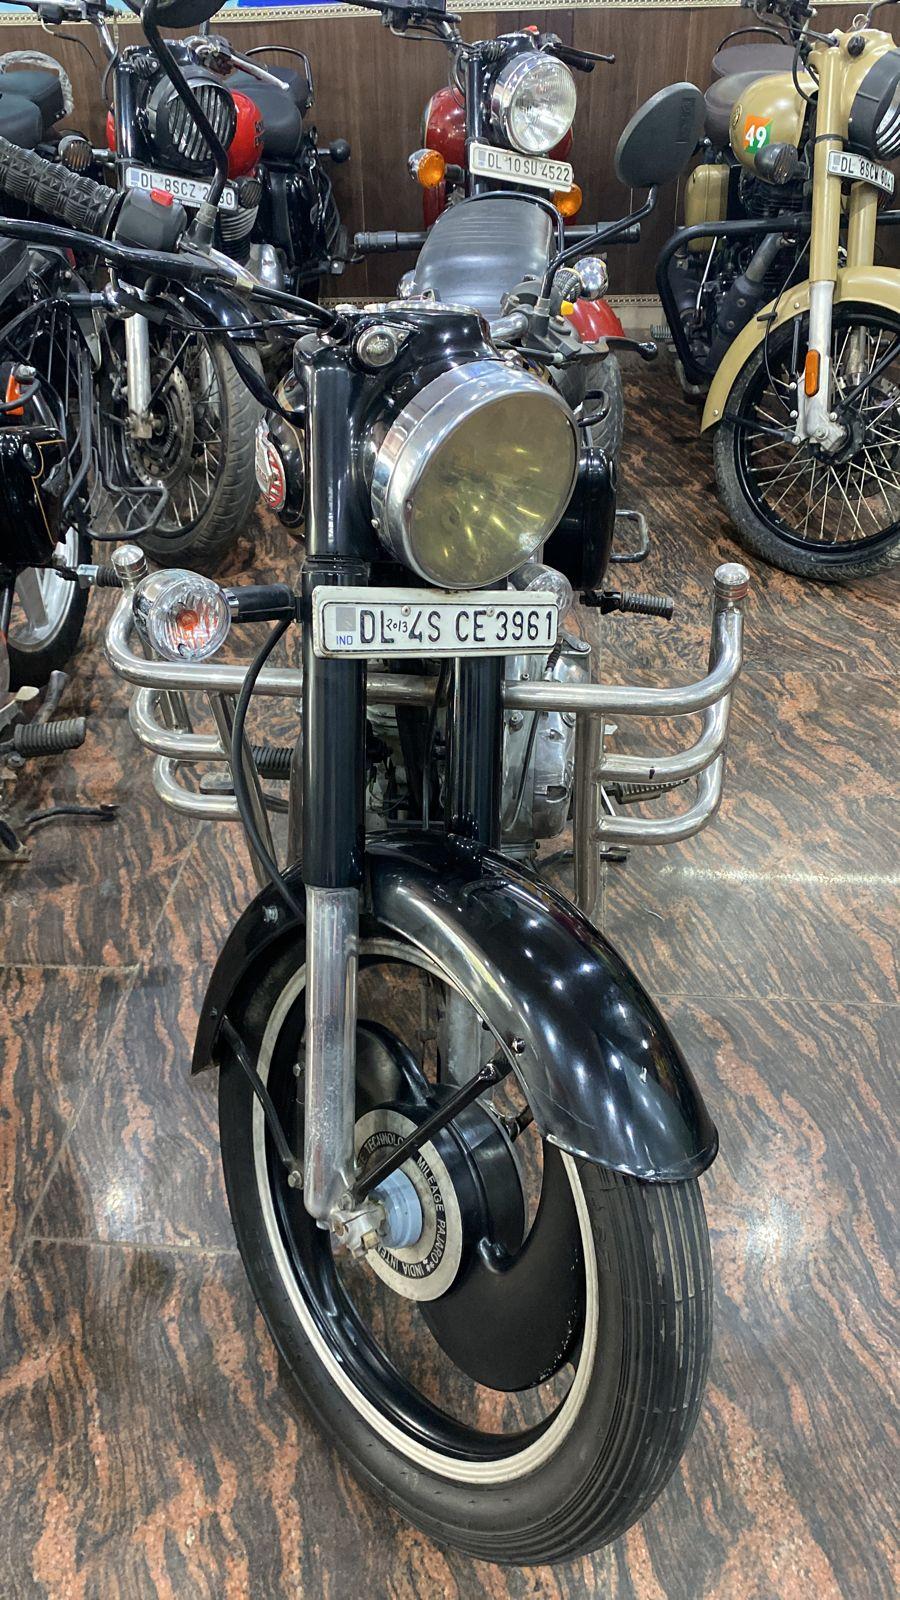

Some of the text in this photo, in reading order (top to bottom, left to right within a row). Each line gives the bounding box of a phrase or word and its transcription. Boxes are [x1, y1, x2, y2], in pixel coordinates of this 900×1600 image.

[745, 125, 767, 148] 49
[488, 152, 502, 169] DL
[542, 164, 570, 182] 4522
[841, 157, 854, 173] DL
[164, 178, 196, 198] 8SCZ
[360, 609, 552, 643] DL 4S CE 3961
[336, 635, 353, 646] IND
[364, 1132, 446, 1264] TECHNOLO MILEAGE PAJARO
[402, 1261, 425, 1277] INDIA
